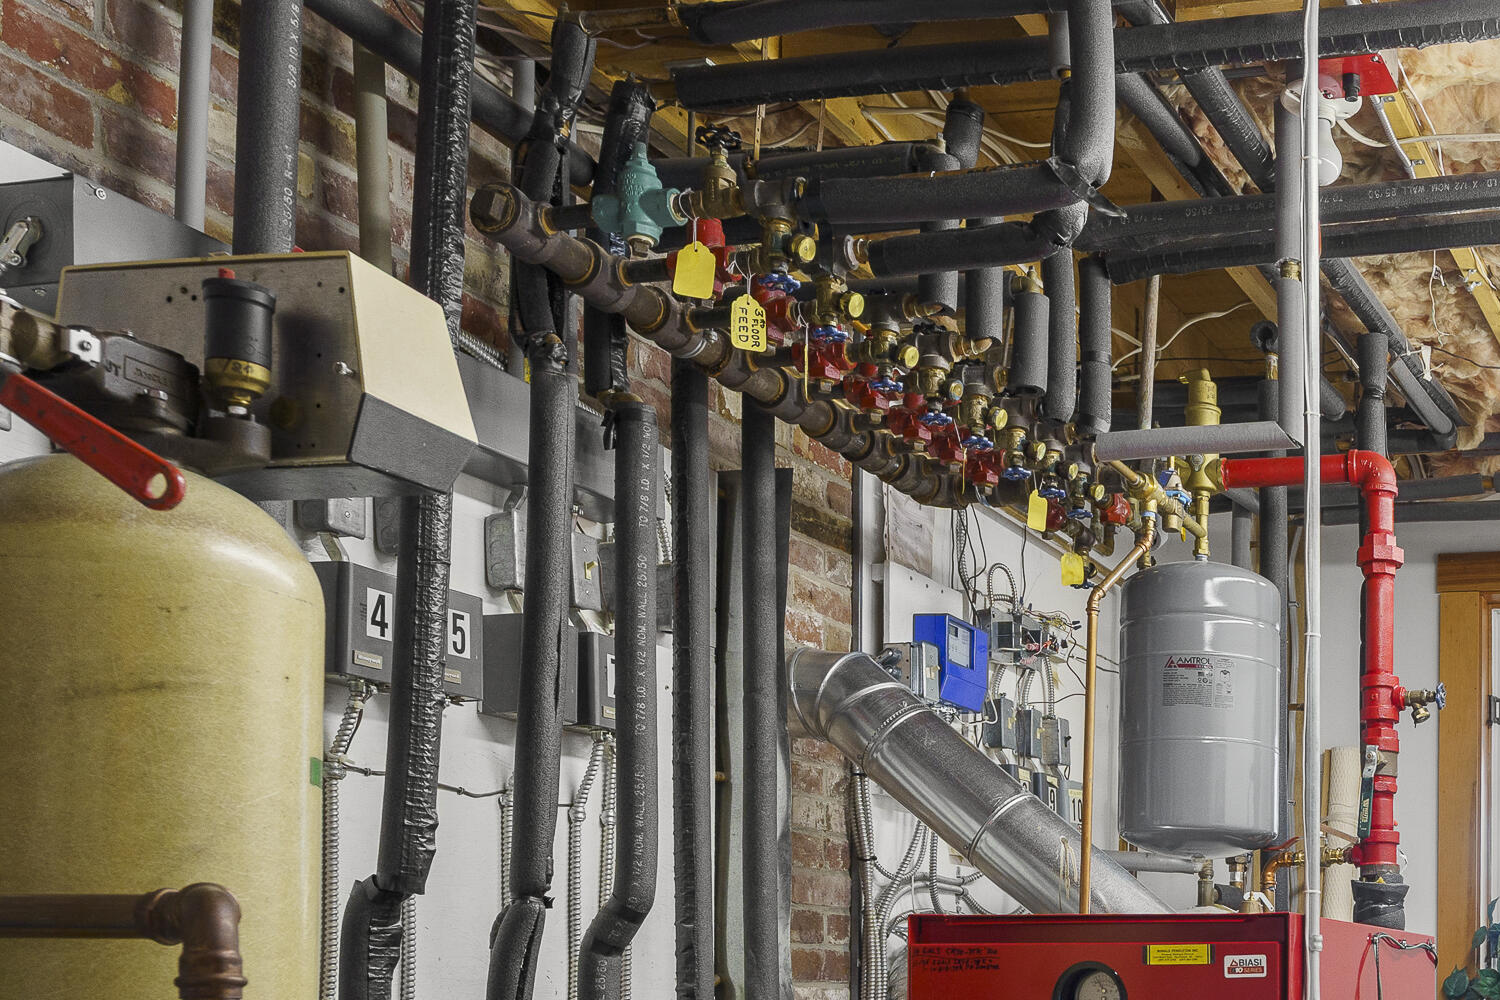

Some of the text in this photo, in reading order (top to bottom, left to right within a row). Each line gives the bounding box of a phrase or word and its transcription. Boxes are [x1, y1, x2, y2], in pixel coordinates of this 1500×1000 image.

[288, 64, 297, 88] 5/8
[738, 306, 749, 343] FEED
[751, 318, 761, 348] FLOOR
[639, 495, 650, 512] 7/8
[370, 594, 389, 638] 4
[452, 612, 466, 655] 5
[1176, 656, 1211, 665] AMTROL
[1071, 798, 1083, 822] 10
[1238, 958, 1262, 967] BIASI
